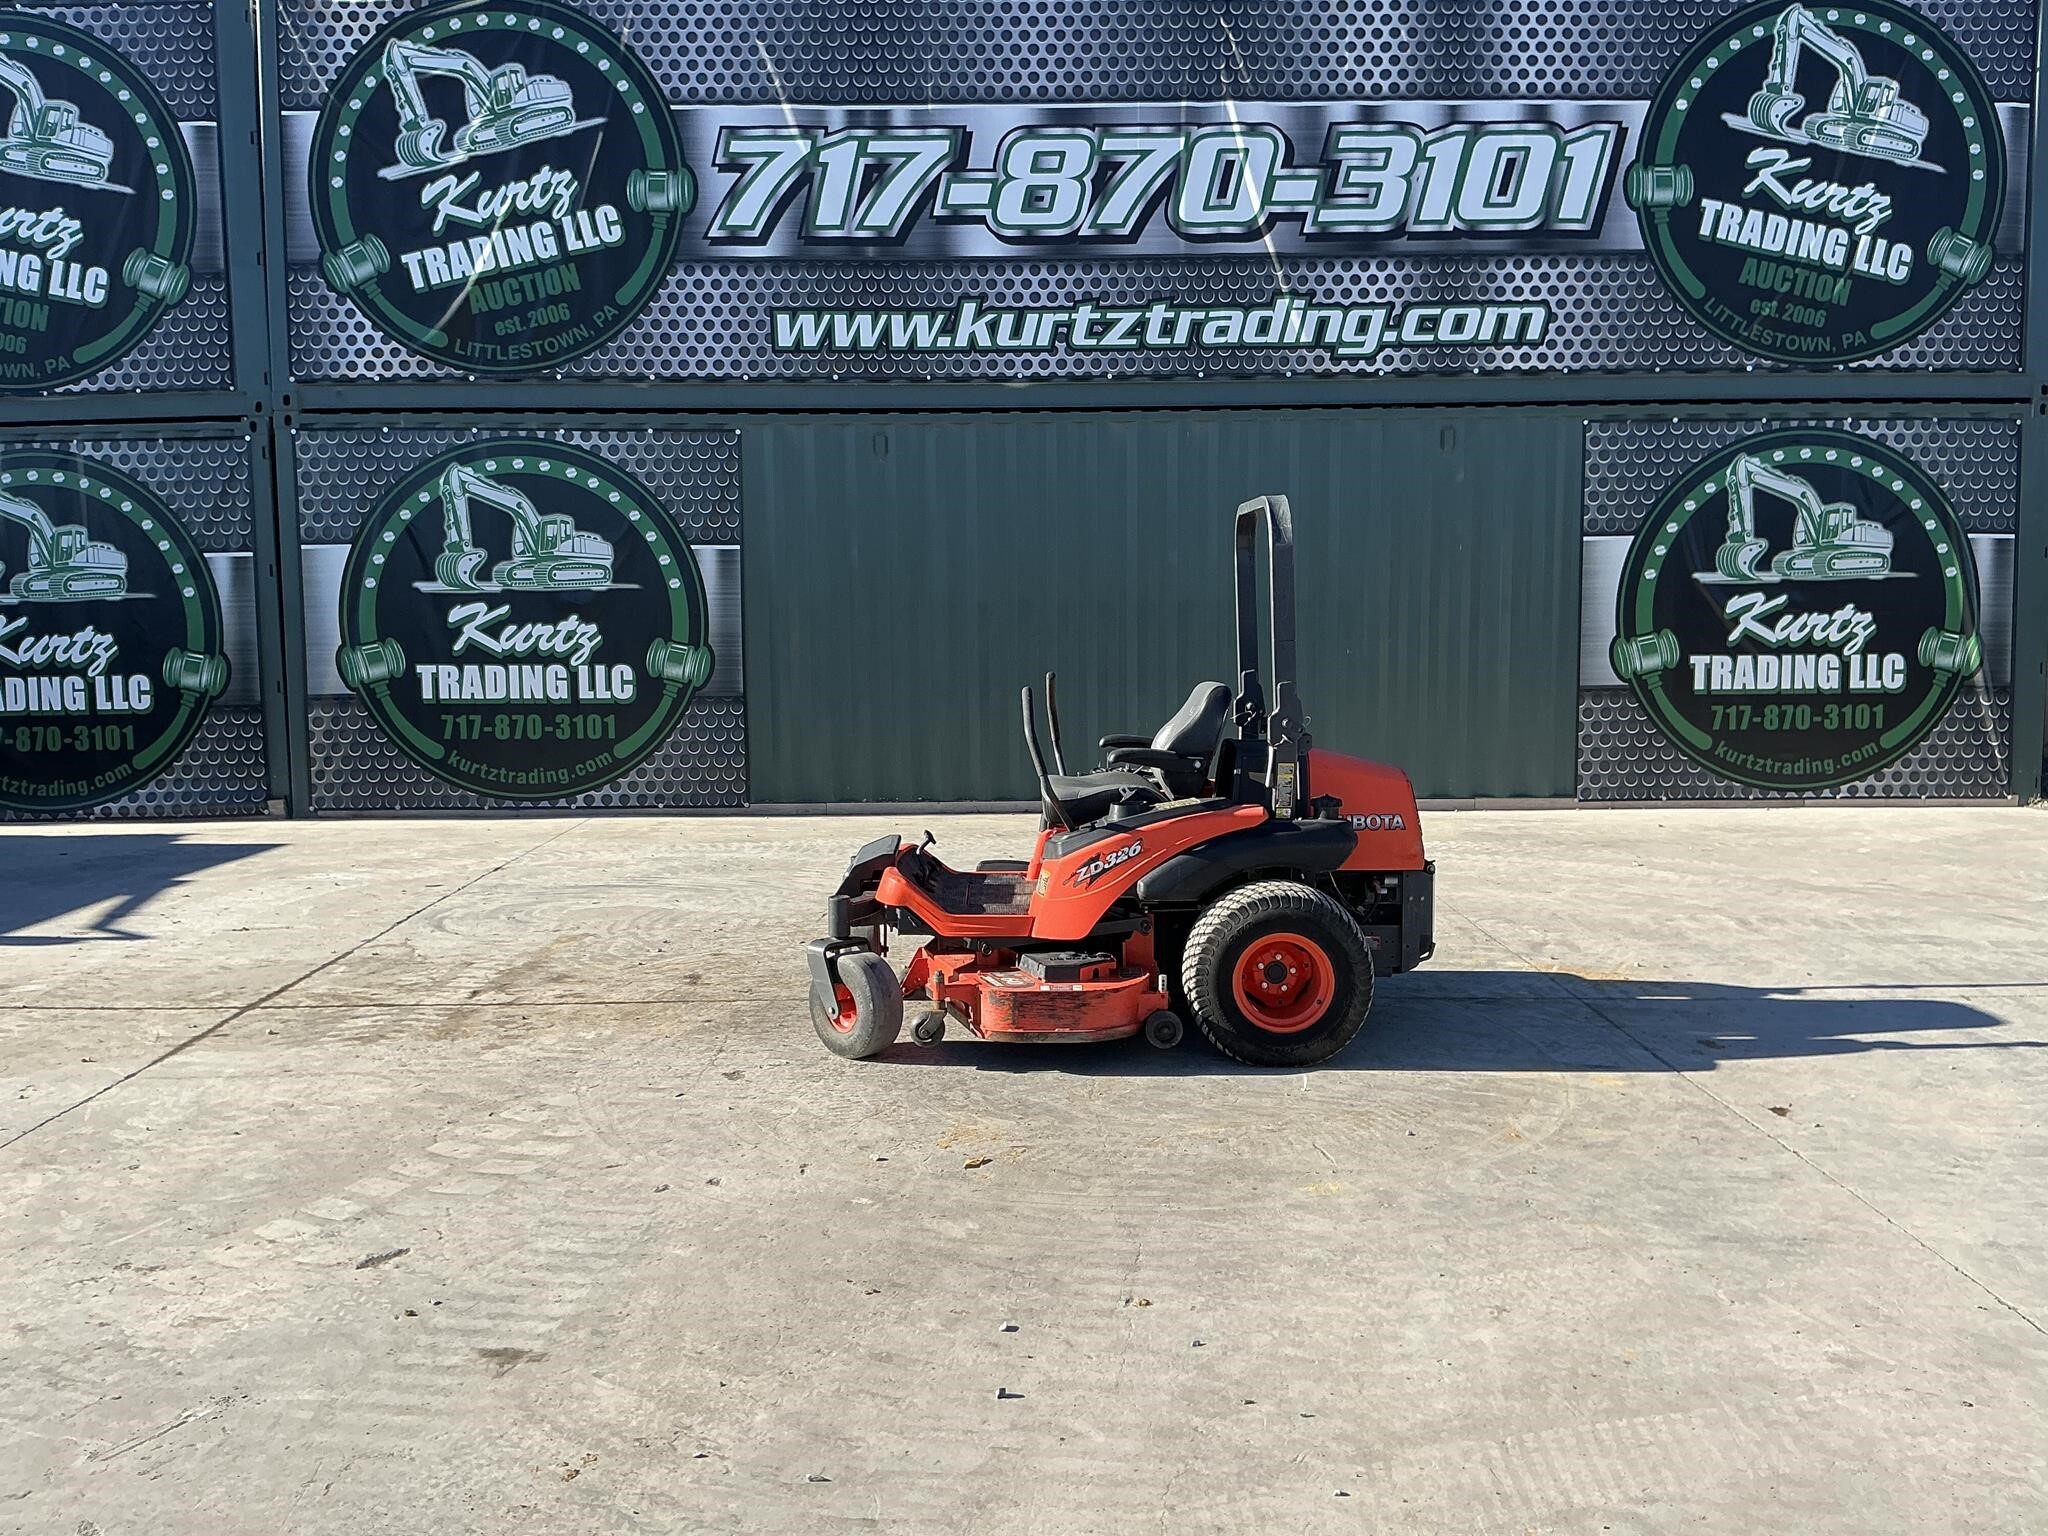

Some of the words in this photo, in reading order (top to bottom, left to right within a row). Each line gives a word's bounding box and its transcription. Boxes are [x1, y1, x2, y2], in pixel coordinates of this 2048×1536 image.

[422, 166, 578, 231] Kurtz
[710, 124, 1620, 238] 717-870-3101
[1744, 147, 1893, 235] Kurtz
[401, 220, 554, 289] TRADING
[565, 205, 622, 251] LLC
[1699, 198, 1849, 268] TRADING
[1854, 235, 1914, 281] LLC
[48, 259, 109, 304] LLC
[469, 263, 582, 315] AUCTION
[1738, 258, 1853, 306] AUCTION
[454, 325, 595, 361] LITTLESTOWN,
[593, 304, 619, 328] PA
[494, 314, 526, 336] est.
[527, 303, 571, 331] 2006
[774, 297, 1549, 357] www.kurtztrading.com
[1703, 298, 1837, 353] LITTLESTOWN,
[1842, 332, 1867, 350] PA
[1749, 298, 1781, 317] est.
[1784, 303, 1827, 328] 2006
[44, 356, 71, 374] PA
[448, 602, 602, 666] Kurtz
[1725, 591, 1877, 656] Kurtz
[0, 675, 86, 711] DING
[95, 674, 151, 710] LLC
[416, 664, 568, 700] TRADING
[578, 663, 635, 700] LLC
[1689, 654, 1840, 691] TRADING
[1850, 653, 1905, 690] LLC
[0, 725, 135, 752] -870-3101
[441, 713, 617, 741] 717-870-3101
[1711, 703, 1884, 732] 717-870-3101
[448, 750, 614, 785] kurtztrading.com
[1715, 741, 1879, 776] kurtztrading.com
[0, 763, 132, 797] tztrading.com
[1346, 814, 1405, 830] BOTA
[1076, 840, 1142, 882] ZD326
